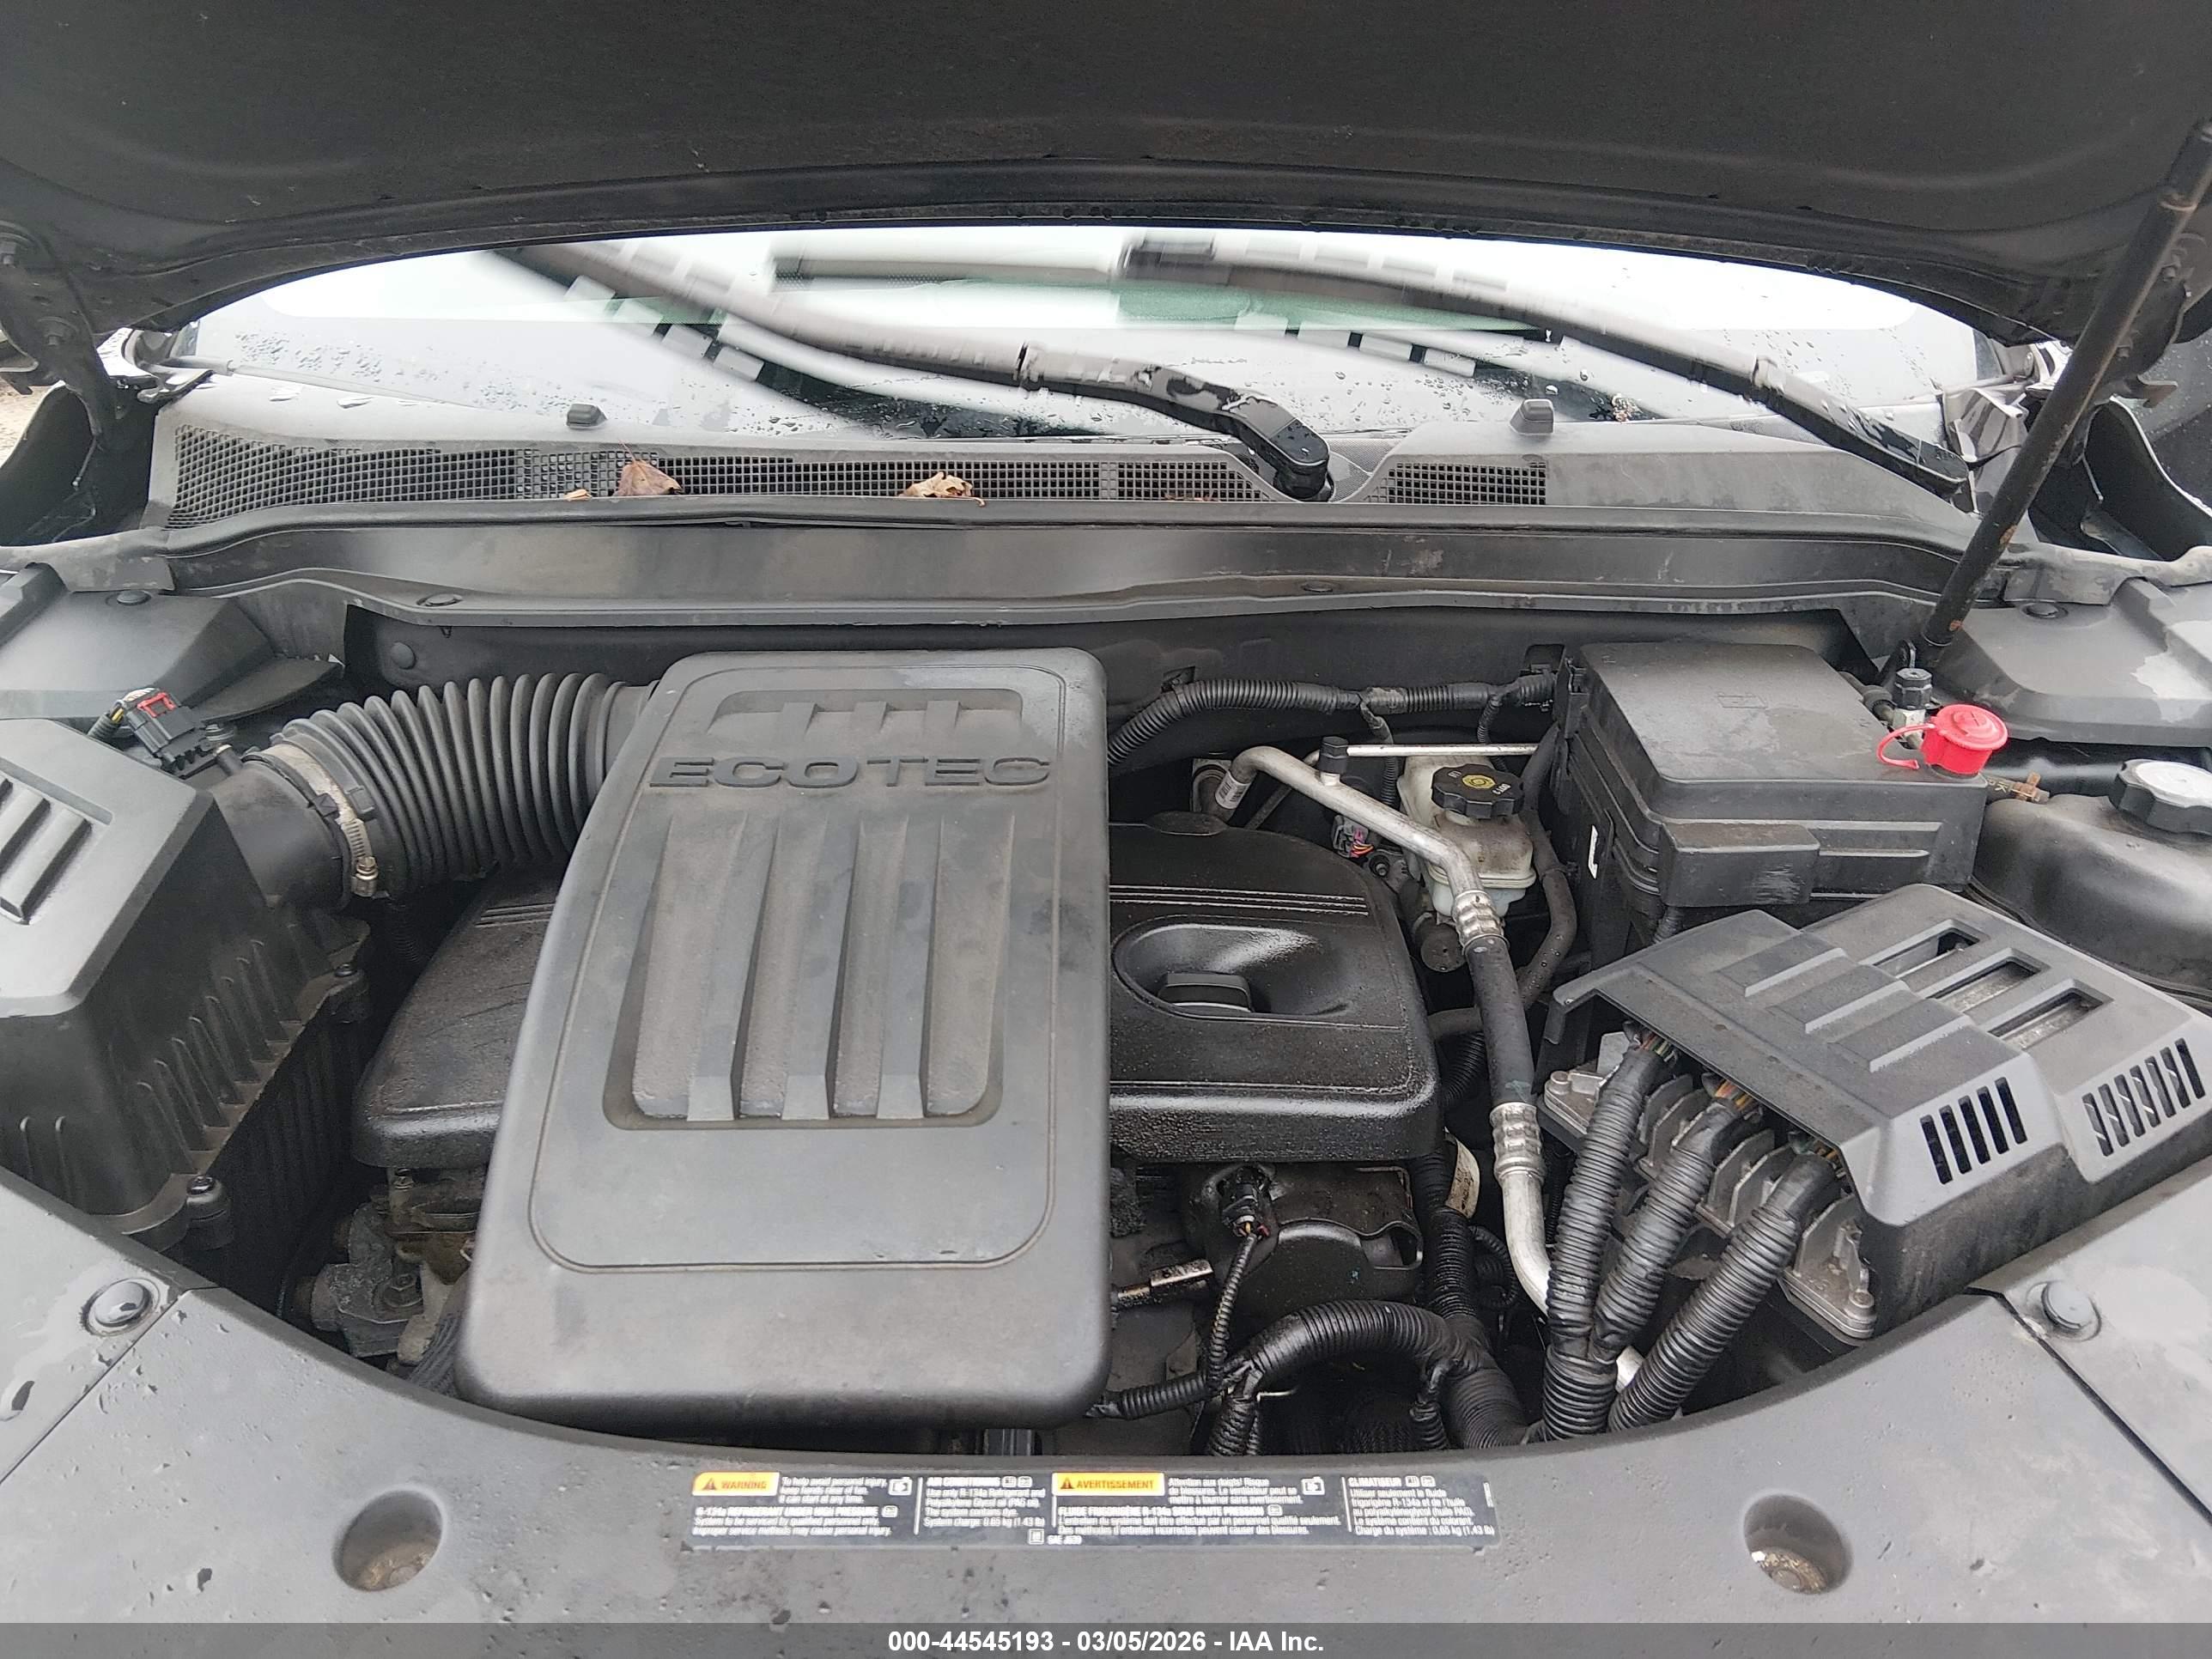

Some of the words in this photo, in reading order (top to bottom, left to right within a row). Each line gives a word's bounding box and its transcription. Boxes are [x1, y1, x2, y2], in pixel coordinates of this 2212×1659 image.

[649, 756, 1050, 787] ECOTEC
[721, 1480, 767, 1489] WARNING
[1076, 1480, 1154, 1489] AVERTISSEMENT
